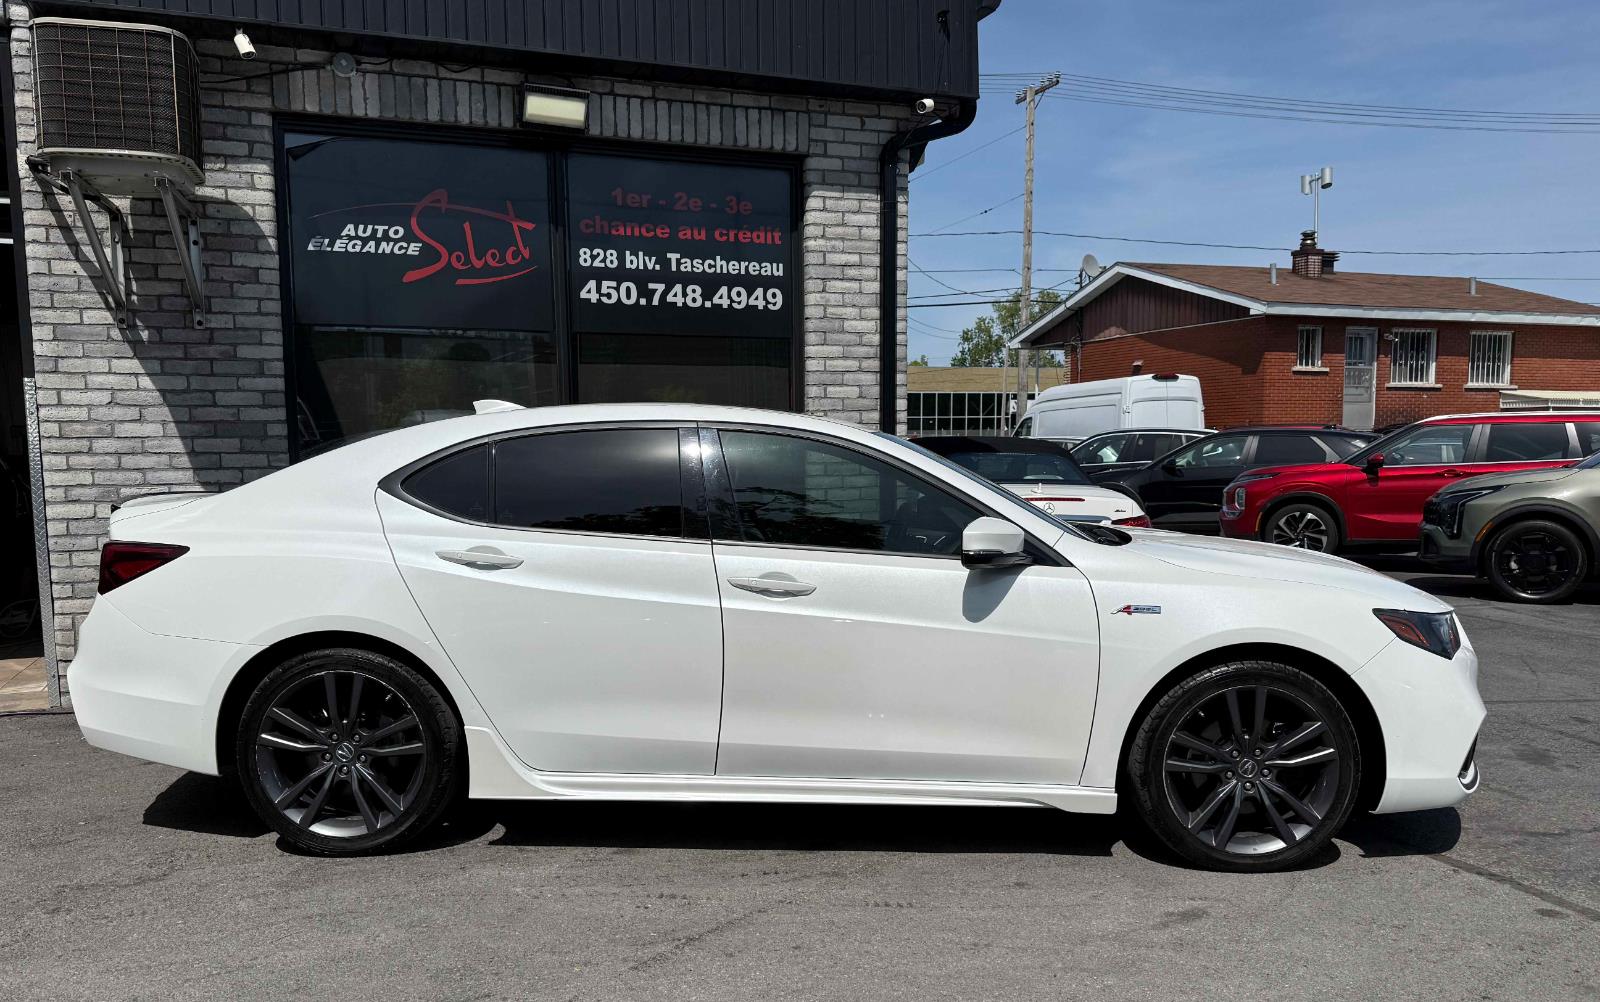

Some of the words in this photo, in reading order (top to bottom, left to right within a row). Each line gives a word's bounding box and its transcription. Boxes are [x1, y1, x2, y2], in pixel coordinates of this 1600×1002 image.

[611, 187, 651, 208] 1er
[673, 191, 703, 212] 2e
[725, 196, 753, 214] 3e
[341, 223, 405, 239] AUTO
[402, 189, 537, 283] Select
[579, 215, 671, 239] chance
[678, 225, 706, 241] au
[714, 224, 782, 245] crédit
[307, 235, 422, 256] ÉLÉGANCE
[578, 247, 619, 269] 828
[625, 250, 661, 271] blv.
[667, 252, 784, 277] Taschereau
[579, 279, 784, 311] 450.748.4949
